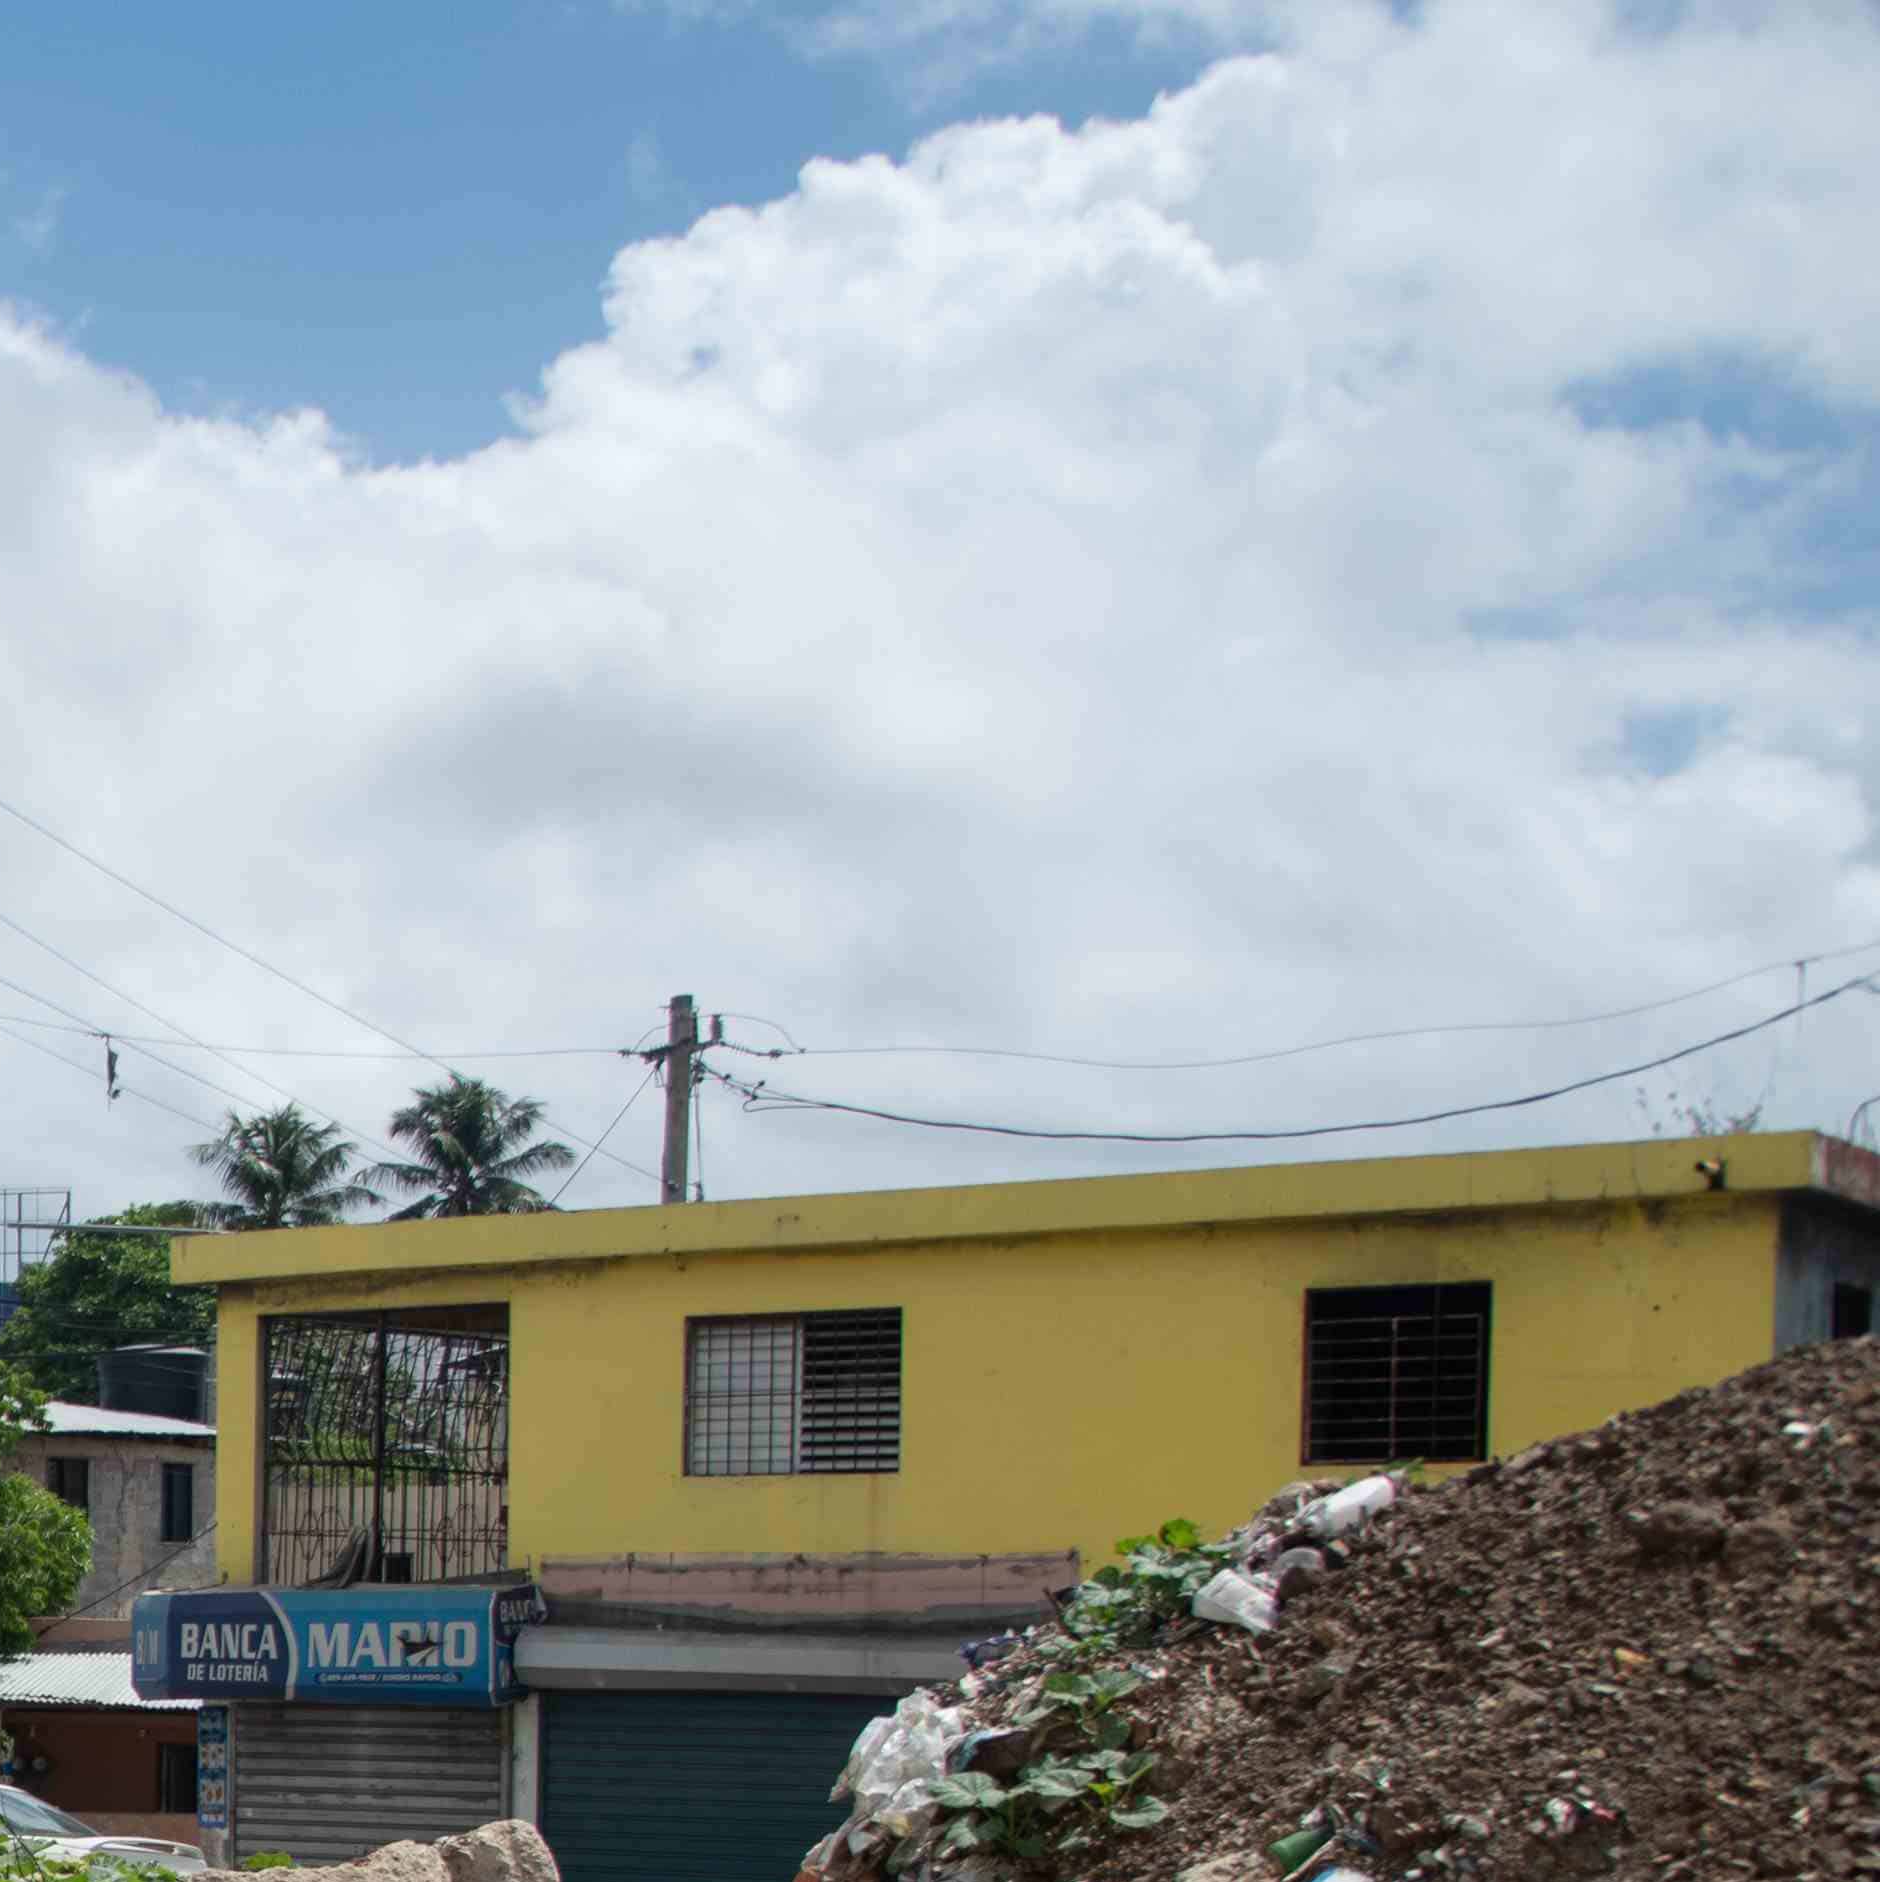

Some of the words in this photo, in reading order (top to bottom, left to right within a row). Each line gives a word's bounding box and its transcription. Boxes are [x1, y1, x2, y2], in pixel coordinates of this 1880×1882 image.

[180, 1622, 278, 1660] BANCA
[186, 1663, 206, 1682] DE
[208, 1662, 269, 1683] LOTERÍA
